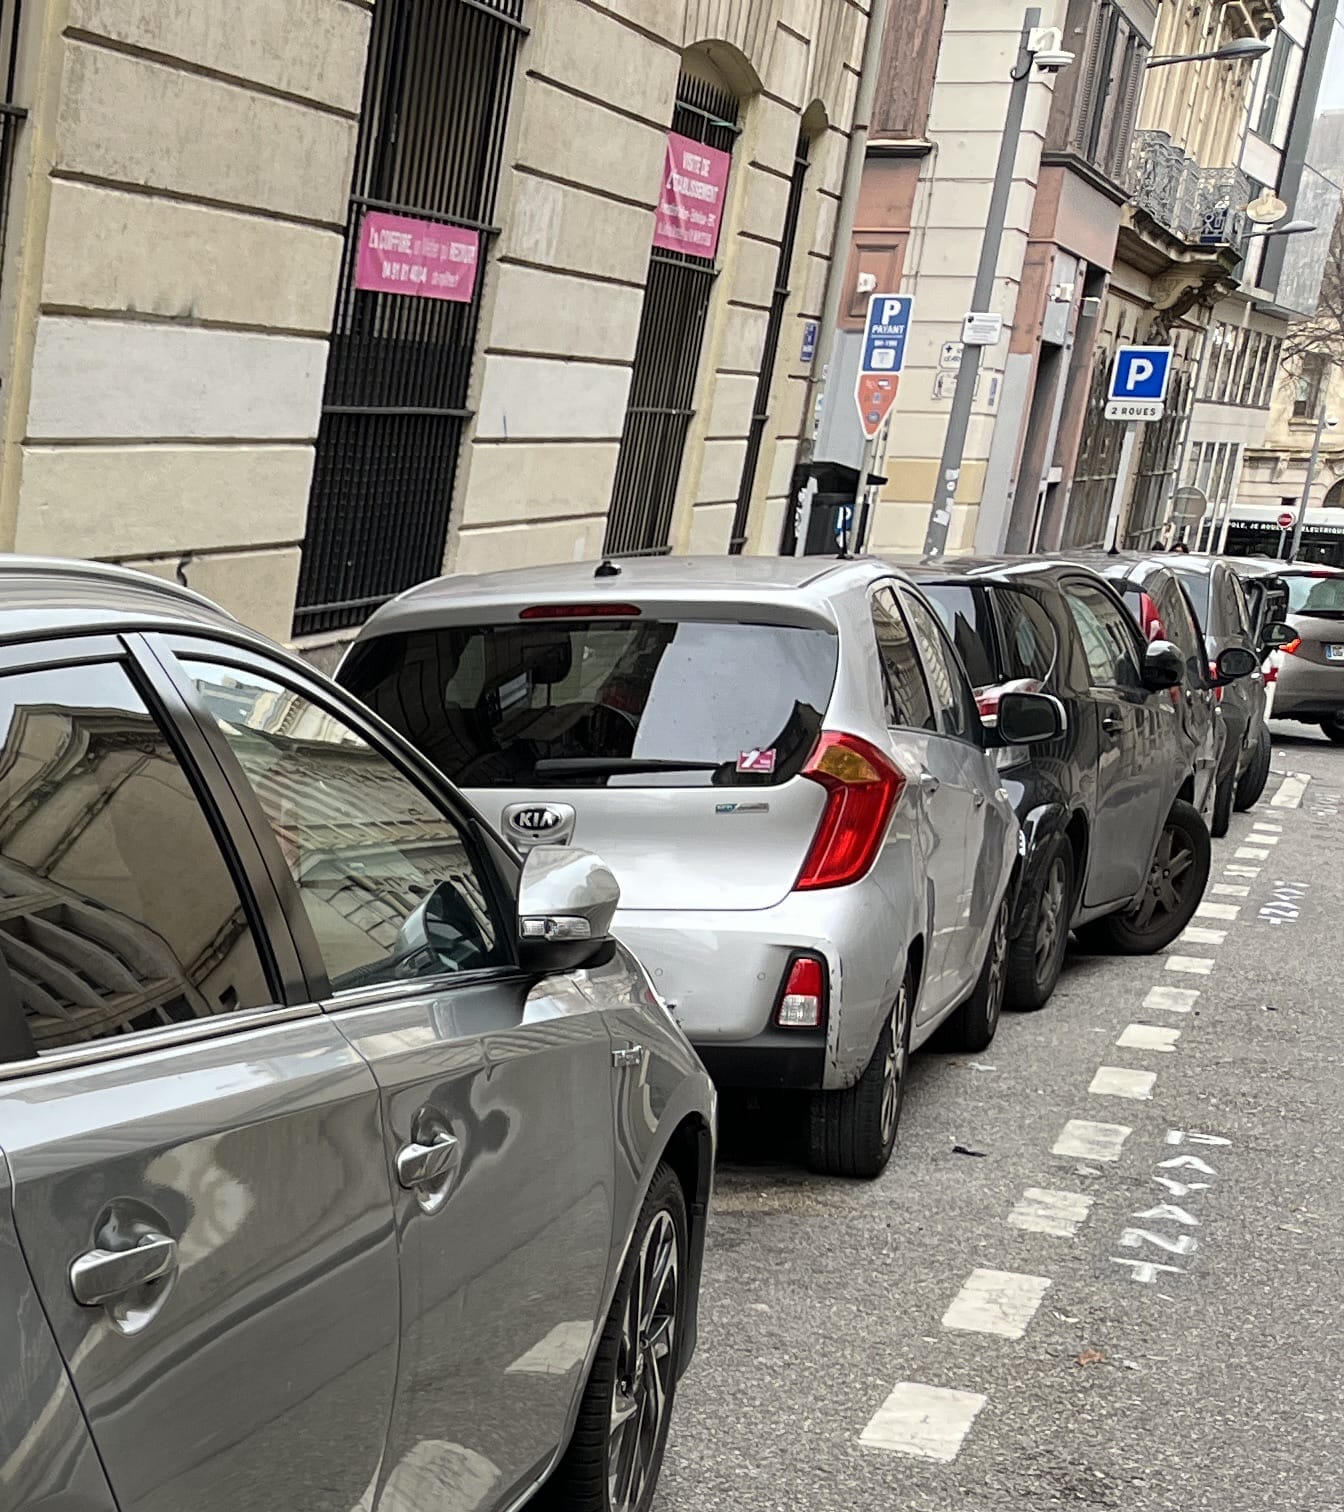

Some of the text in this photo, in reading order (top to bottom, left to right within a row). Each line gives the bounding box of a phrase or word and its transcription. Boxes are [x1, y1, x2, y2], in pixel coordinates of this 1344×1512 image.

[882, 299, 901, 324] P
[871, 324, 905, 334] PAYANT
[1126, 358, 1153, 391] P
[1111, 407, 1156, 416] 2 ROUES
[519, 811, 554, 827] KIA
